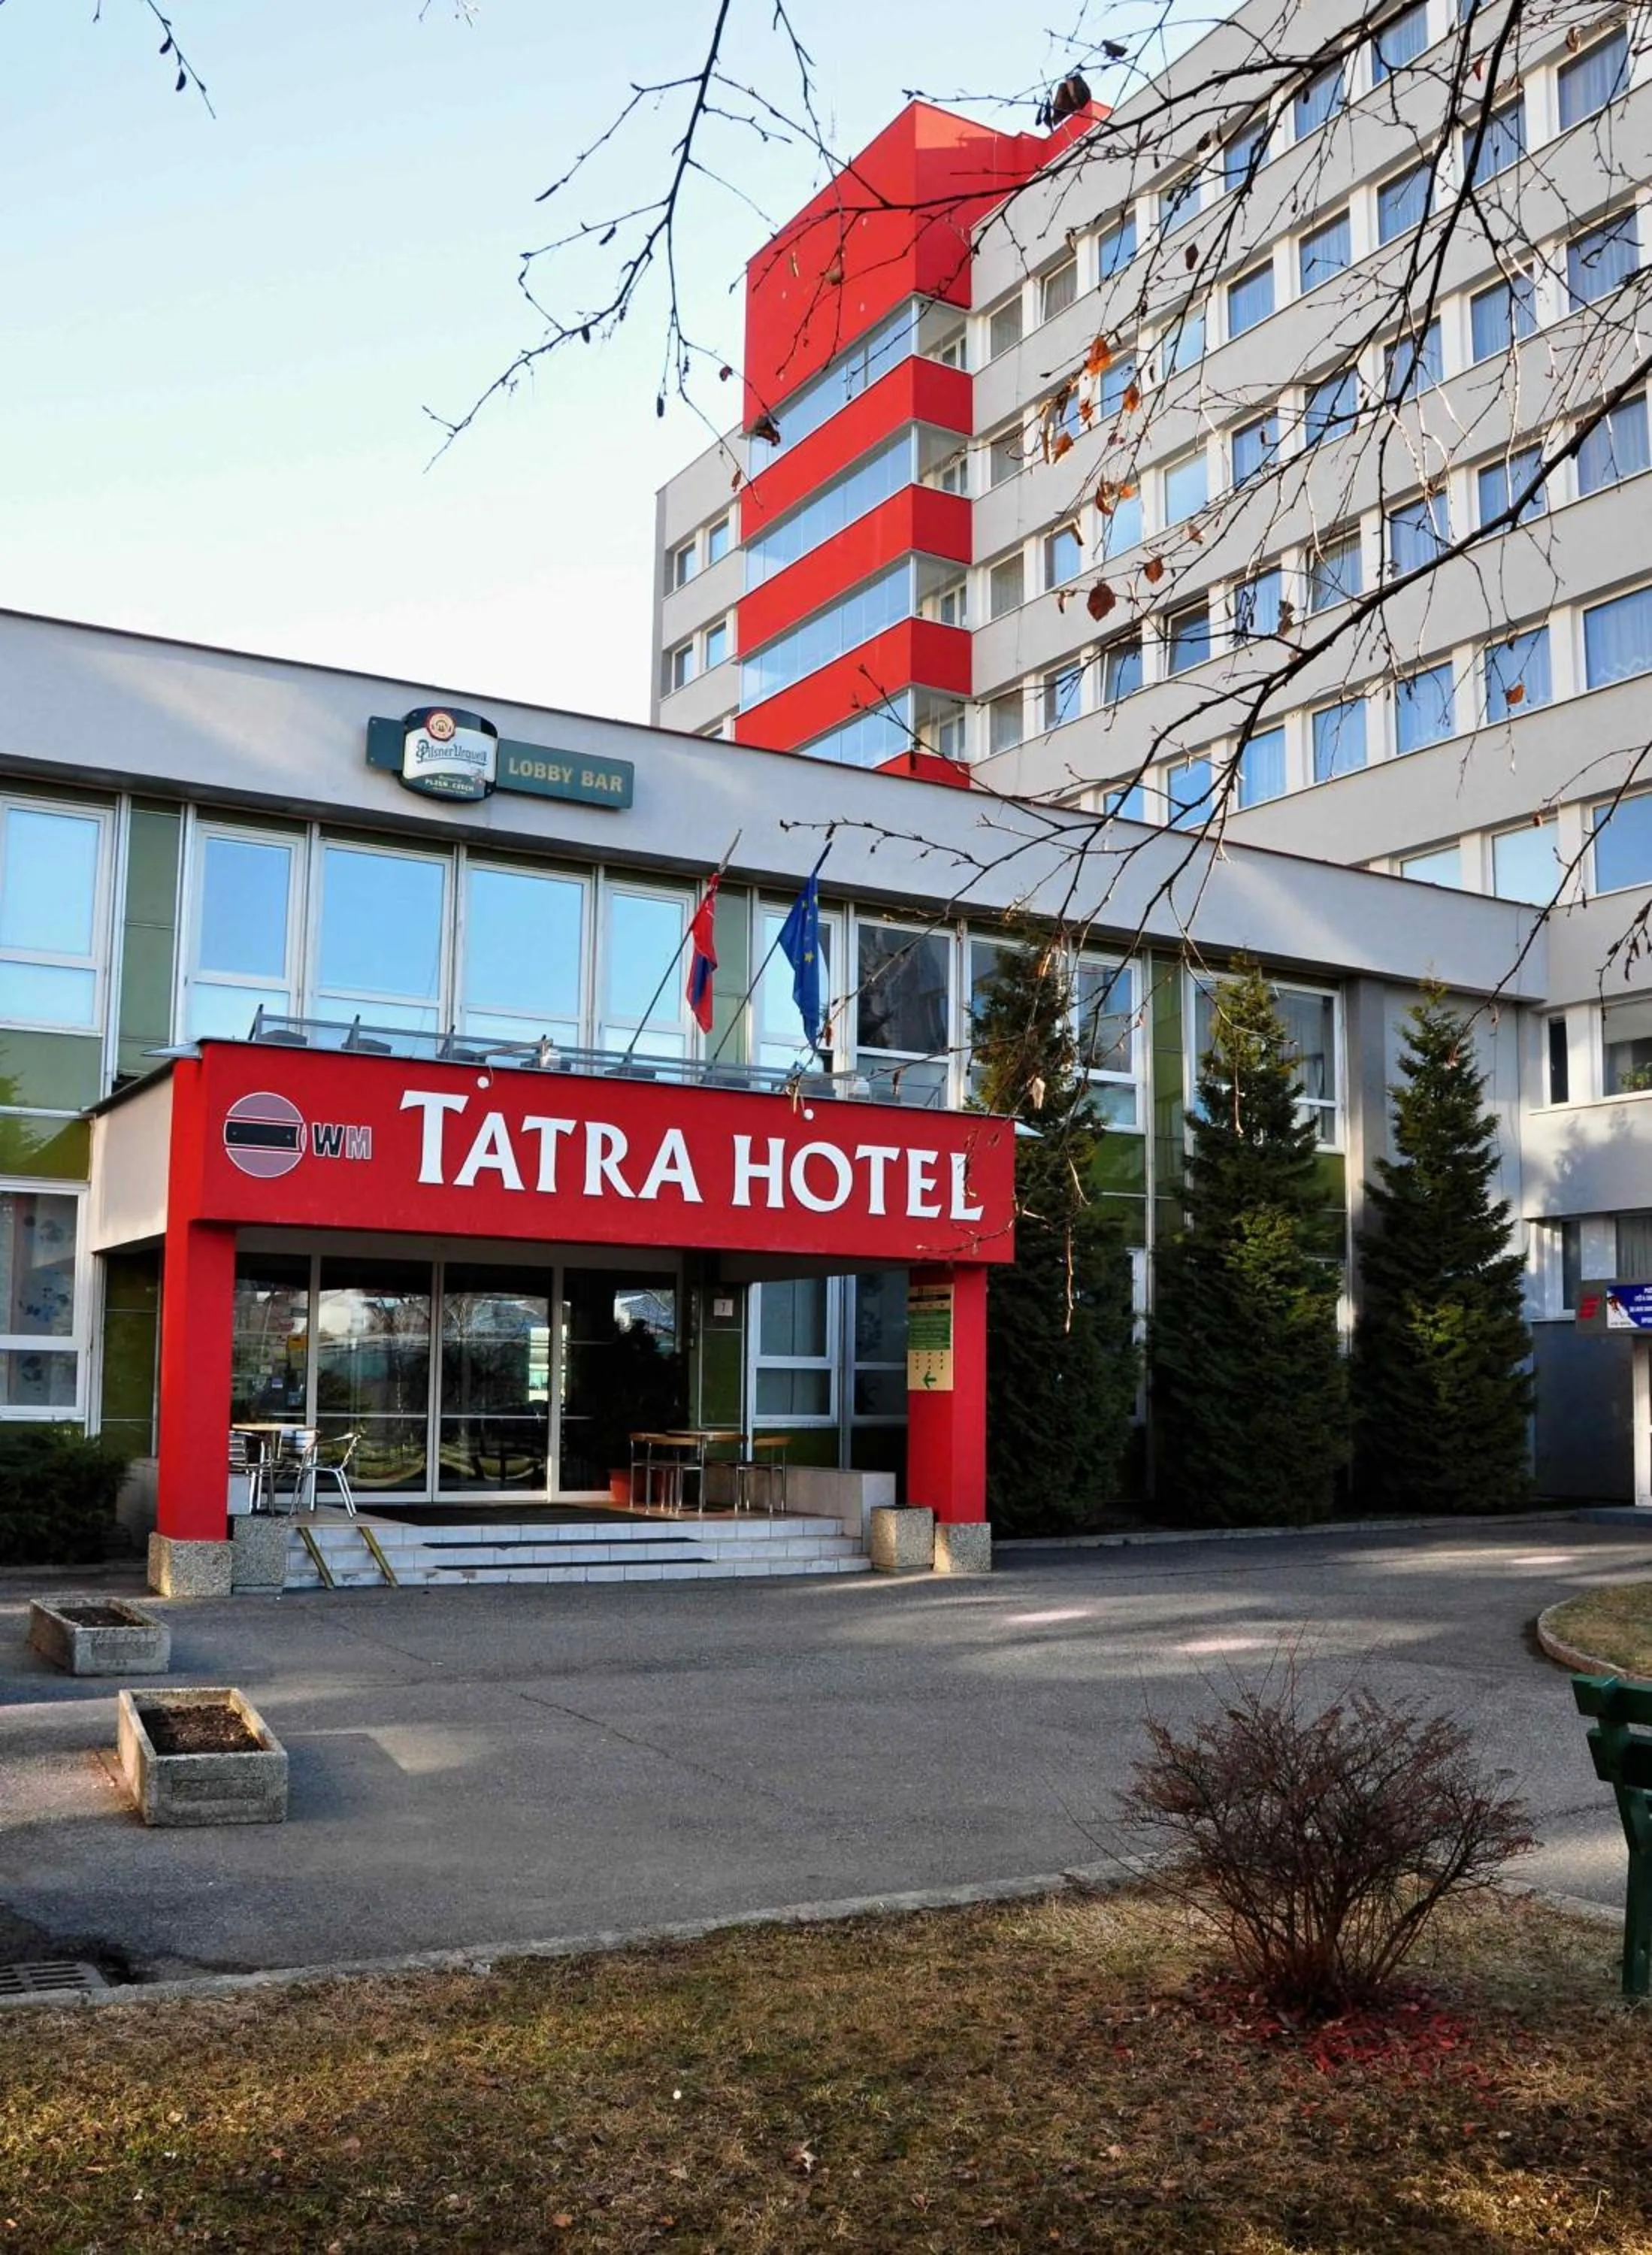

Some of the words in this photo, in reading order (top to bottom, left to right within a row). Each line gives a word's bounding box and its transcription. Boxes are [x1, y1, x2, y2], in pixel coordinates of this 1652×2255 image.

[416, 739, 453, 764] Pilsner
[508, 757, 573, 784] LOBBY
[581, 770, 623, 793] BAR
[312, 1122, 372, 1160] WM
[399, 1089, 703, 1203] TATRA
[731, 1134, 984, 1221] HOTEL
